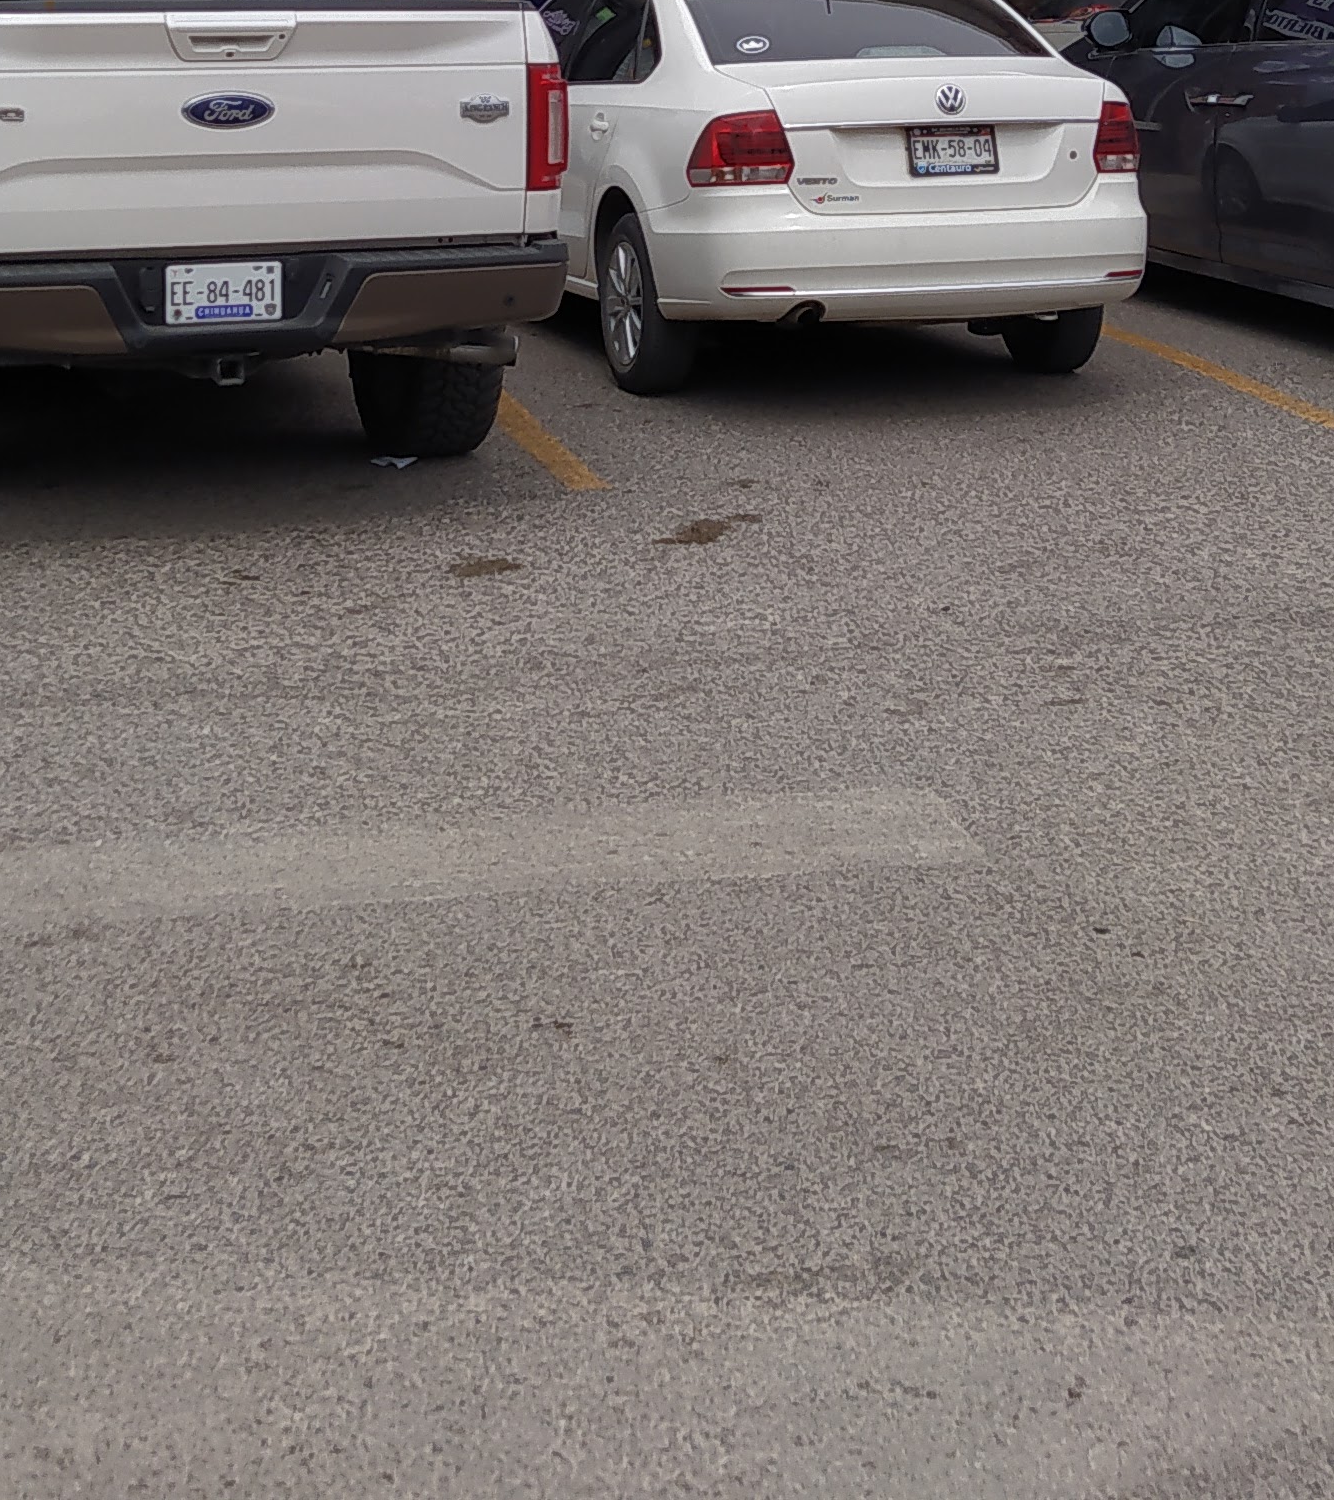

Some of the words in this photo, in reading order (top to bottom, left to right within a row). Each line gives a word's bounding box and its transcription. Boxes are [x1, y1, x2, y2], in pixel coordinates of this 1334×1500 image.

[203, 100, 254, 121] Ford
[929, 164, 972, 173] Centauro
[826, 194, 860, 203] Surman
[170, 279, 276, 307] EE-84-481
